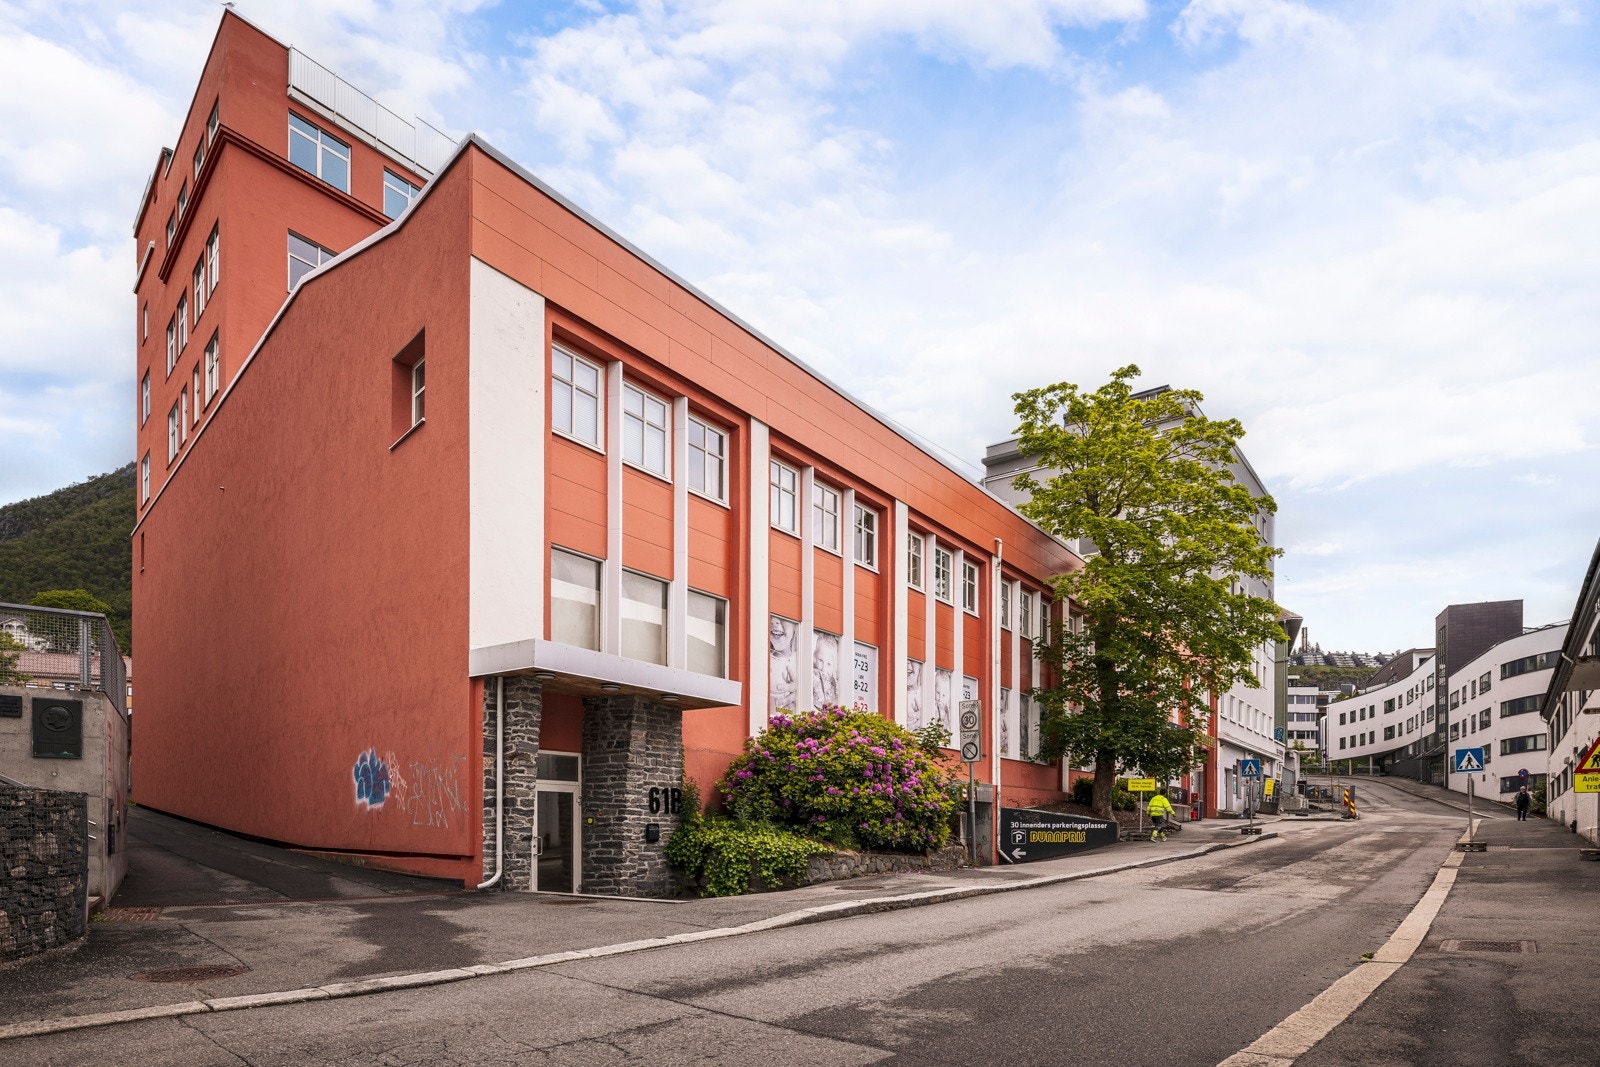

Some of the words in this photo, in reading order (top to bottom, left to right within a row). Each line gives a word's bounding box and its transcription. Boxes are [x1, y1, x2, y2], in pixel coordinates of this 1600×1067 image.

[854, 659, 868, 671] 7-23
[854, 680, 868, 692] 8-22
[963, 716, 974, 726] 30
[649, 787, 682, 814] 61B
[1052, 822, 1107, 830] parkeringsplasser
[1015, 834, 1023, 843] P
[1029, 831, 1087, 842] BUNNPRIS
